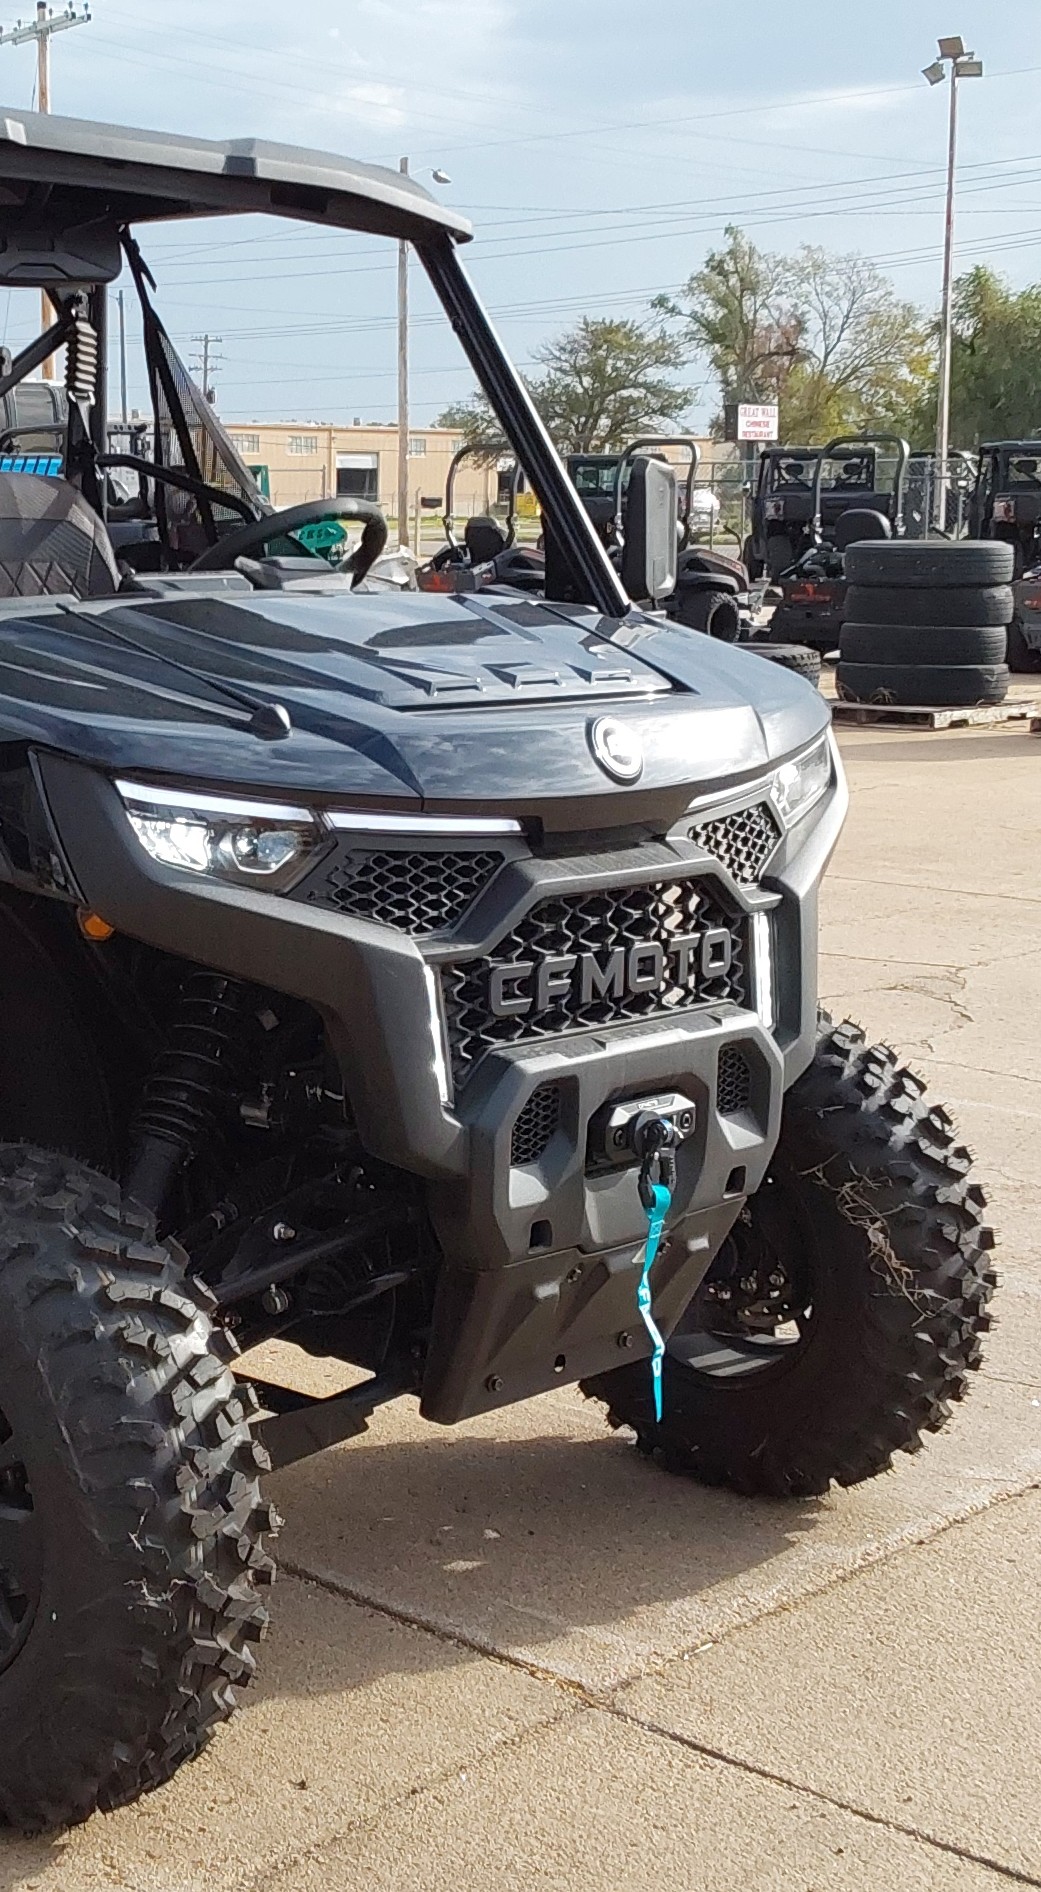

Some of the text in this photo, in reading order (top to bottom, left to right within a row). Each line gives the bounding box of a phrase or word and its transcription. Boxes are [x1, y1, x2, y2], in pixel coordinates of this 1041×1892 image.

[741, 407, 776, 417] GREAT WALL
[746, 421, 770, 429] CHINESE
[490, 928, 732, 1017] CFMOTO
